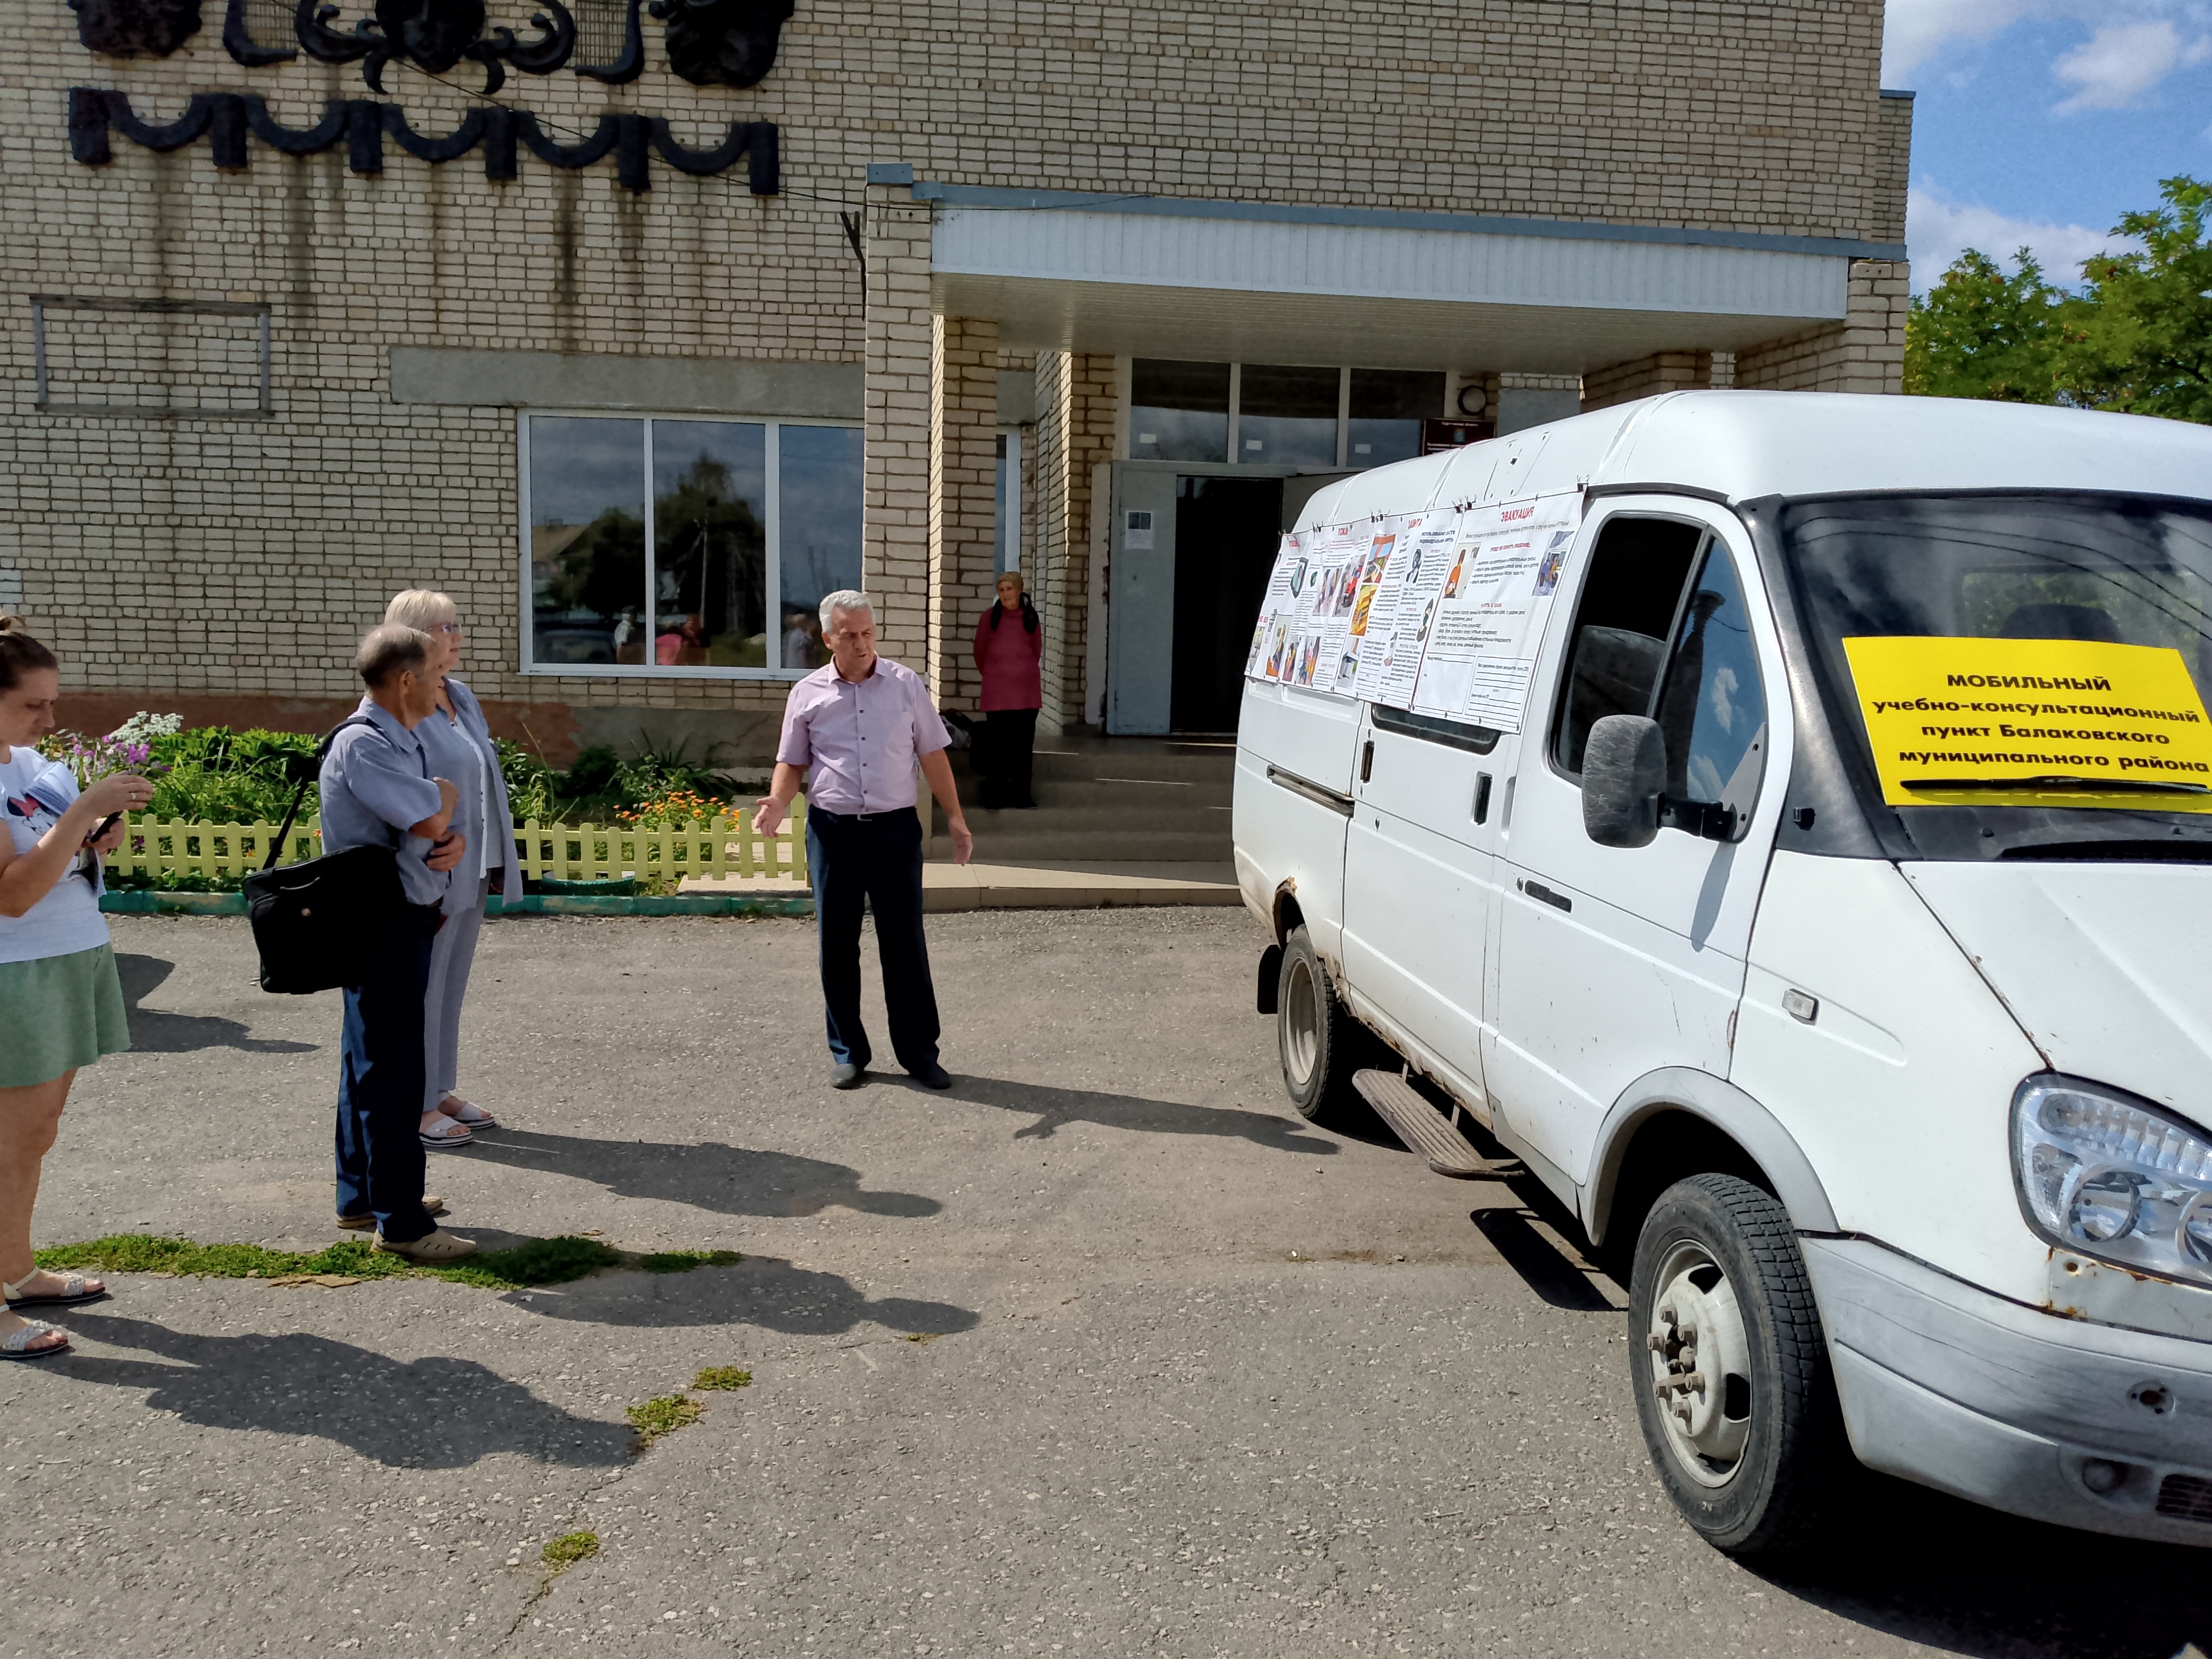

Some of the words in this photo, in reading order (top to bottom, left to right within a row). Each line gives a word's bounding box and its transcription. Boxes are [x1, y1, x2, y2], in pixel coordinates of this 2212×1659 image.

[1501, 506, 1535, 523] ЭВАКУАЦИЯ
[1947, 674, 2112, 691] МОБИЛЬНЫЙ
[1872, 698, 2200, 723] учебно-консультационный
[1921, 726, 1991, 740] пункт
[1998, 724, 2170, 744] Балаковского
[1899, 752, 2109, 766] муниципального
[2118, 756, 2210, 773] района
